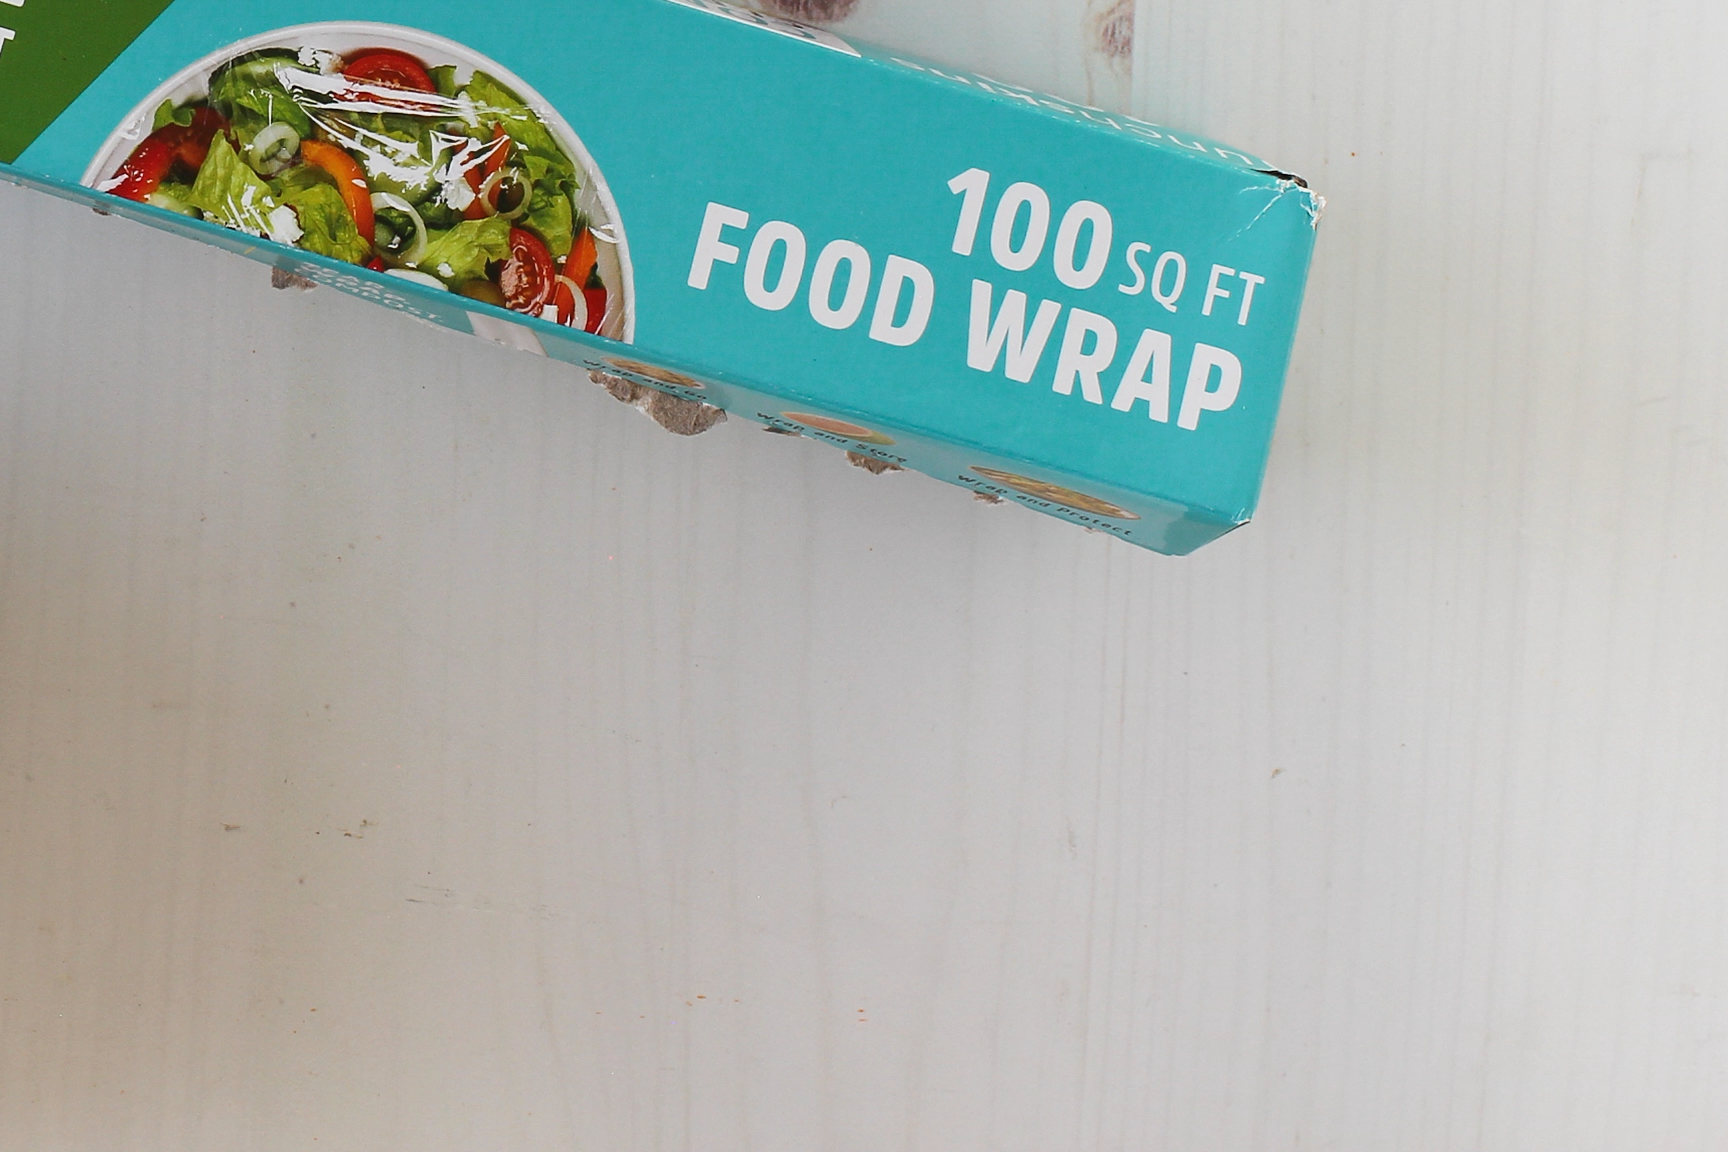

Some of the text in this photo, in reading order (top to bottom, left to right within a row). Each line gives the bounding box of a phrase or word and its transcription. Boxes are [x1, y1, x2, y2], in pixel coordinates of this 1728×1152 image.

[946, 167, 1266, 326] 100 SQ FT
[687, 201, 1243, 431] FOOD WRAP
[756, 410, 909, 464] Wrap and Store
[957, 472, 1133, 537] Wrap and Protect
